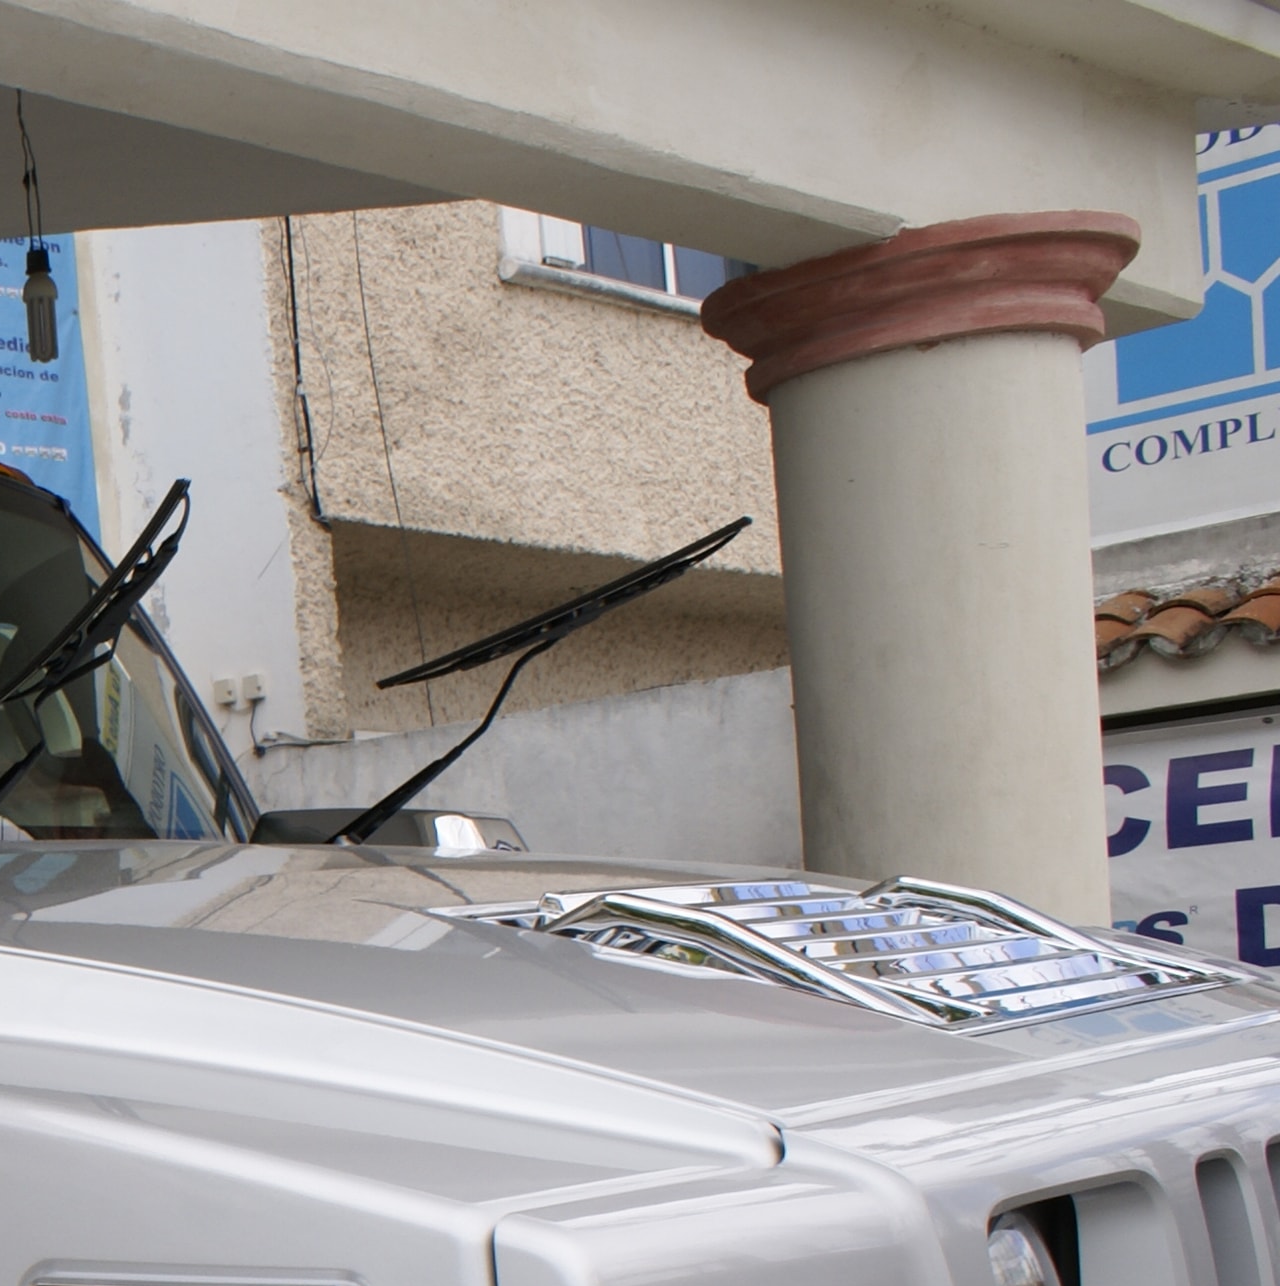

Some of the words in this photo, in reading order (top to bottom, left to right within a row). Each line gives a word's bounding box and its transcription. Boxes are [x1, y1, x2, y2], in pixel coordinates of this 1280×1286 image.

[40, 370, 59, 383] de
[1101, 405, 1280, 473] COMPL
[1102, 744, 1280, 858] CE
